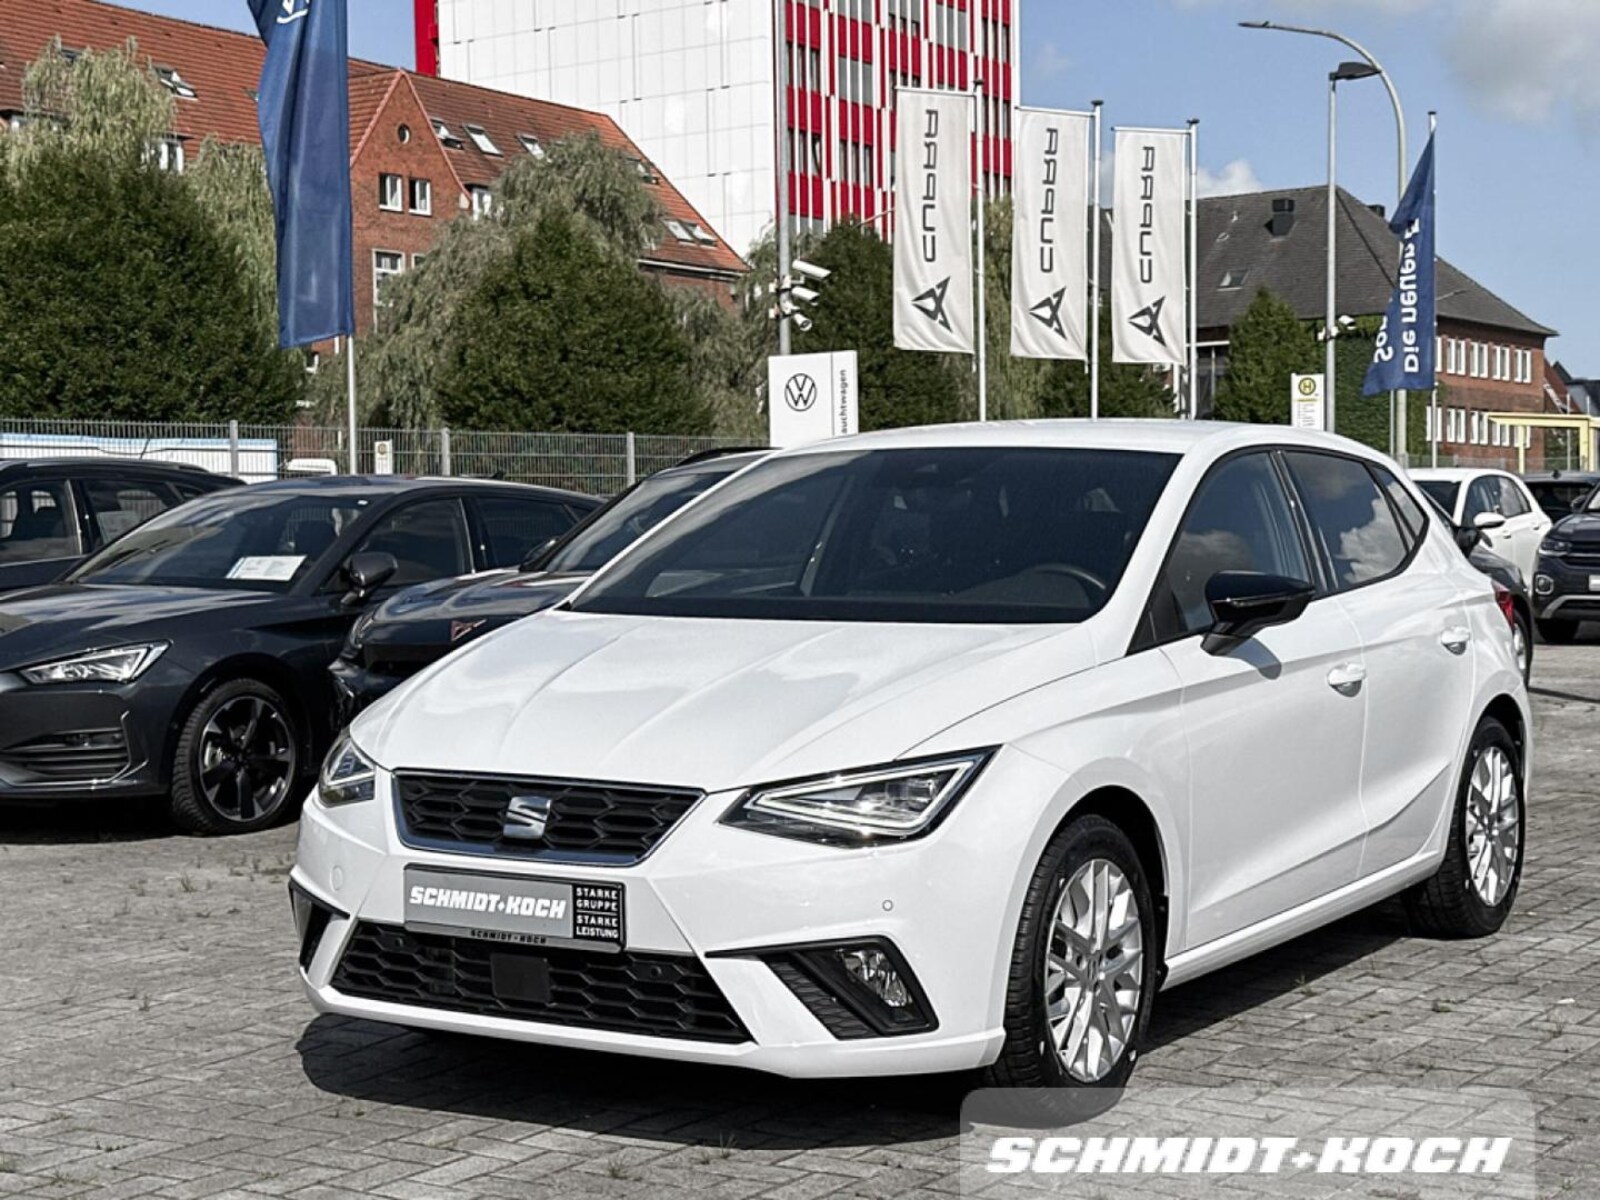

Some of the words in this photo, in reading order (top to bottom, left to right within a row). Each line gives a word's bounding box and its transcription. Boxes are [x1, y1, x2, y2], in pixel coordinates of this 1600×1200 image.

[576, 887, 618, 900] STARKE
[576, 899, 618, 912] GRUPPE
[576, 915, 618, 928] STARKE
[576, 927, 619, 939] LEISTUNG
